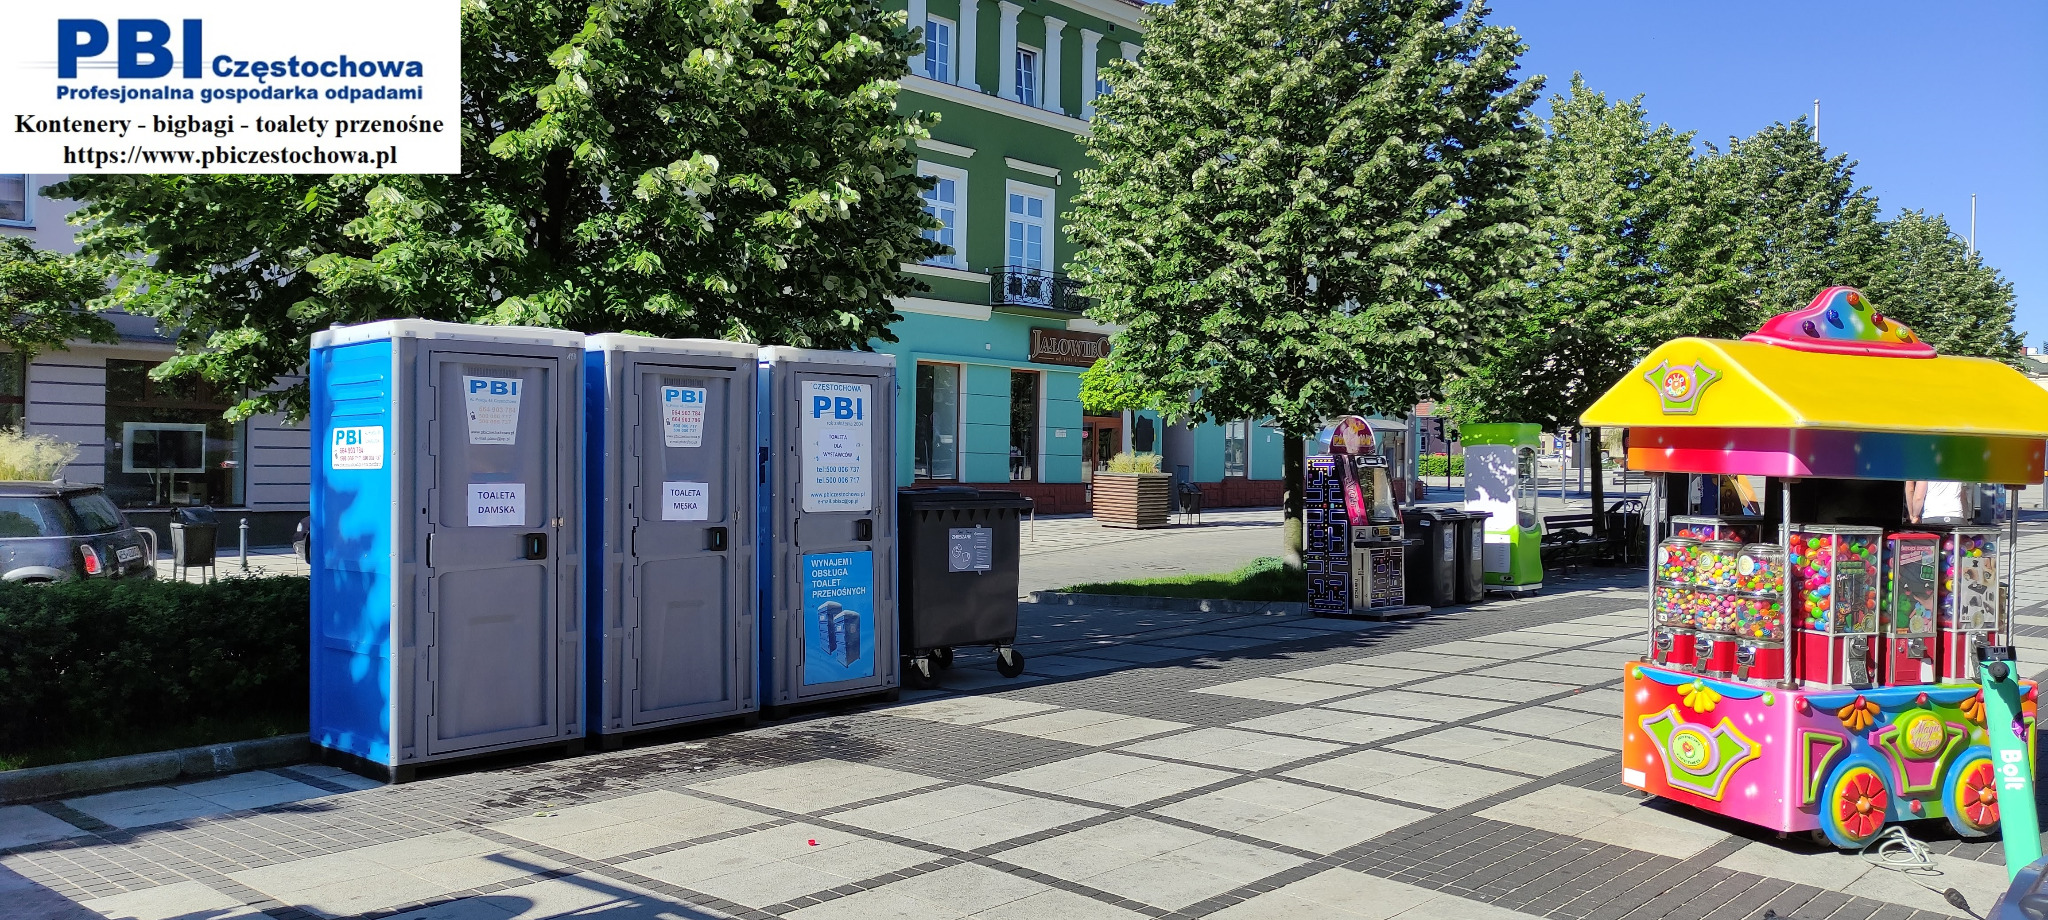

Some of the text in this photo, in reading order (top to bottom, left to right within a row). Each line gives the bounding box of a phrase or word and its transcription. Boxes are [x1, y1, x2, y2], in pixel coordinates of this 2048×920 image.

[1032, 329, 1110, 358] JAŁOWIEC
[470, 380, 517, 395] PBI
[812, 383, 862, 392] CZĘSTOCHOWA
[665, 389, 703, 403] PBI
[813, 396, 863, 420] PBI
[335, 429, 362, 446] PBI
[477, 491, 516, 499] TOALETA
[670, 489, 701, 497] TOALETA
[478, 506, 516, 514] DAMSKA
[673, 502, 698, 510] MĘSKA
[811, 557, 853, 568] WYNAJEM I
[811, 568, 849, 578] OBSŁUGA
[811, 579, 842, 588] TOALET
[812, 587, 866, 599] PRZENOŚNYCH
[1997, 749, 2026, 790] Bolt
